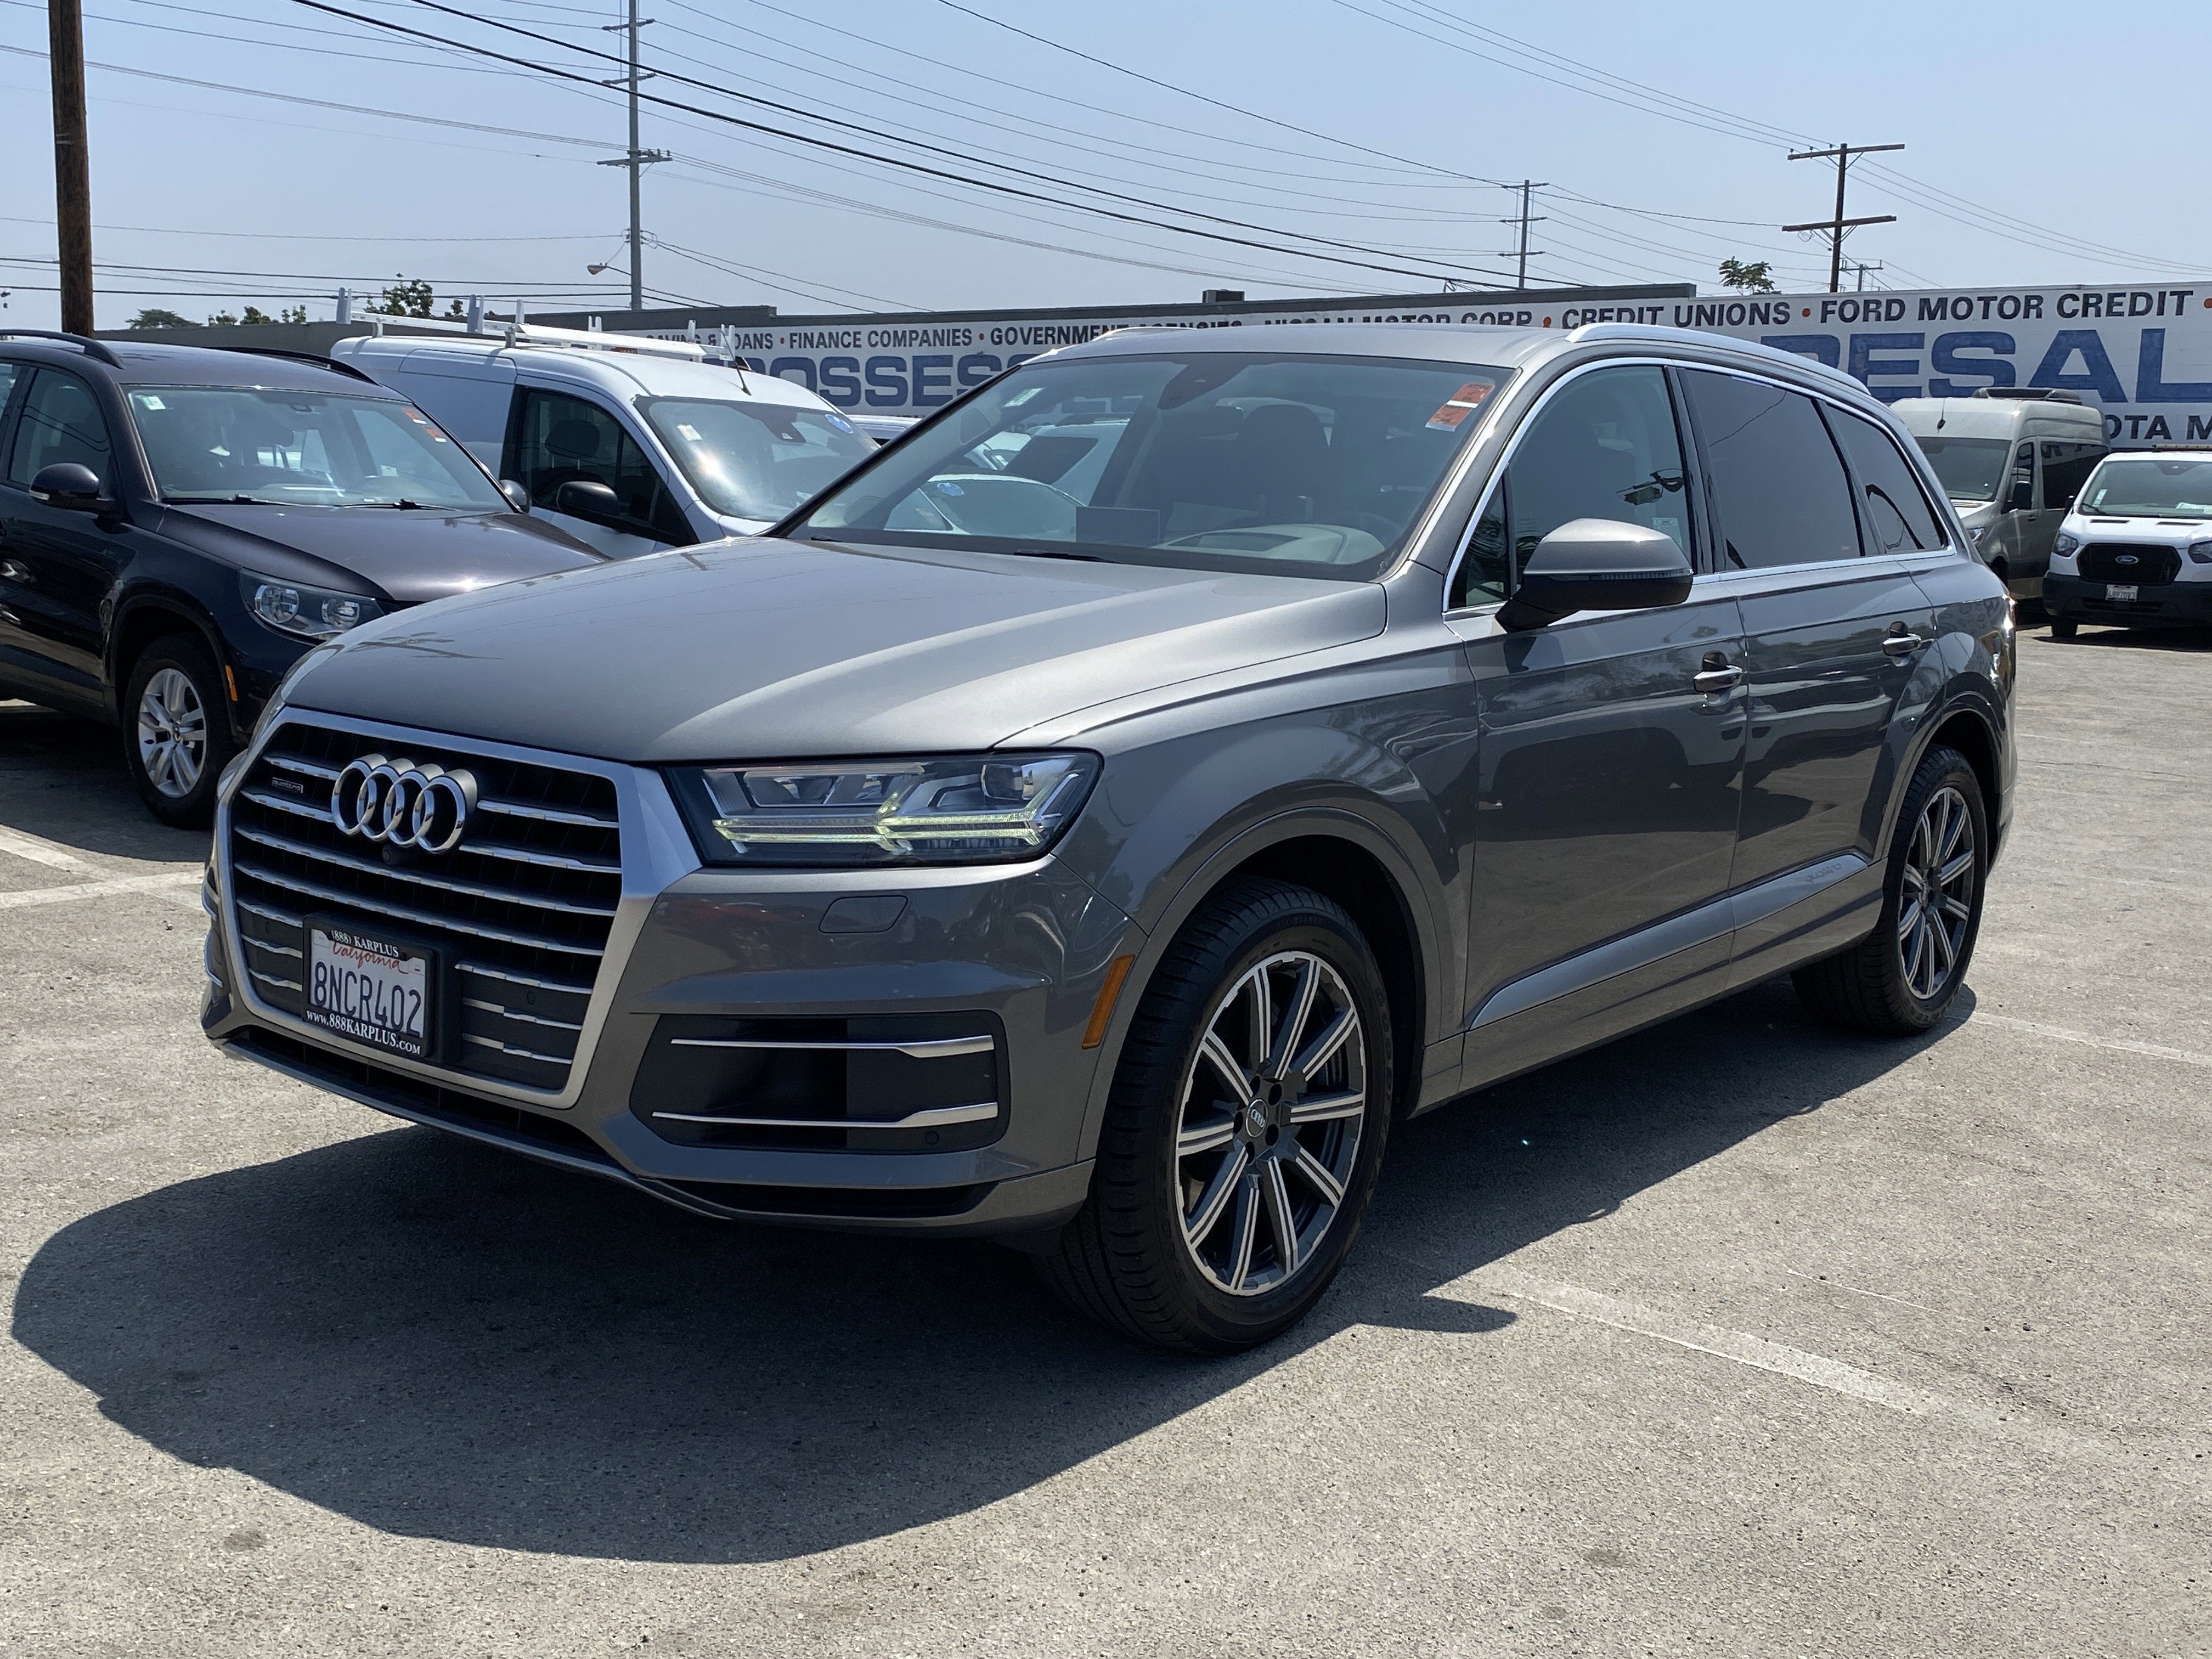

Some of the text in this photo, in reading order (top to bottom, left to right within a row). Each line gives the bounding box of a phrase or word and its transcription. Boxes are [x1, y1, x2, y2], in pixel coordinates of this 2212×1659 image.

[734, 332, 774, 349] OANS
[789, 331, 862, 349] FINANCE
[867, 328, 973, 348] COMPANIES
[990, 324, 1130, 346] GOVERNME
[1561, 306, 1664, 329] CREDIT
[1674, 302, 1791, 328] UNIONS
[1820, 298, 1906, 324] FORD
[1917, 295, 2044, 321] MOTOR
[2056, 290, 2194, 319] CREDIT
[331, 929, 399, 957] (888) KARPLUS
[332, 941, 409, 975] California
[314, 961, 422, 1038] 8NCR402
[306, 1010, 421, 1055] www.888KARPLUS.COM
